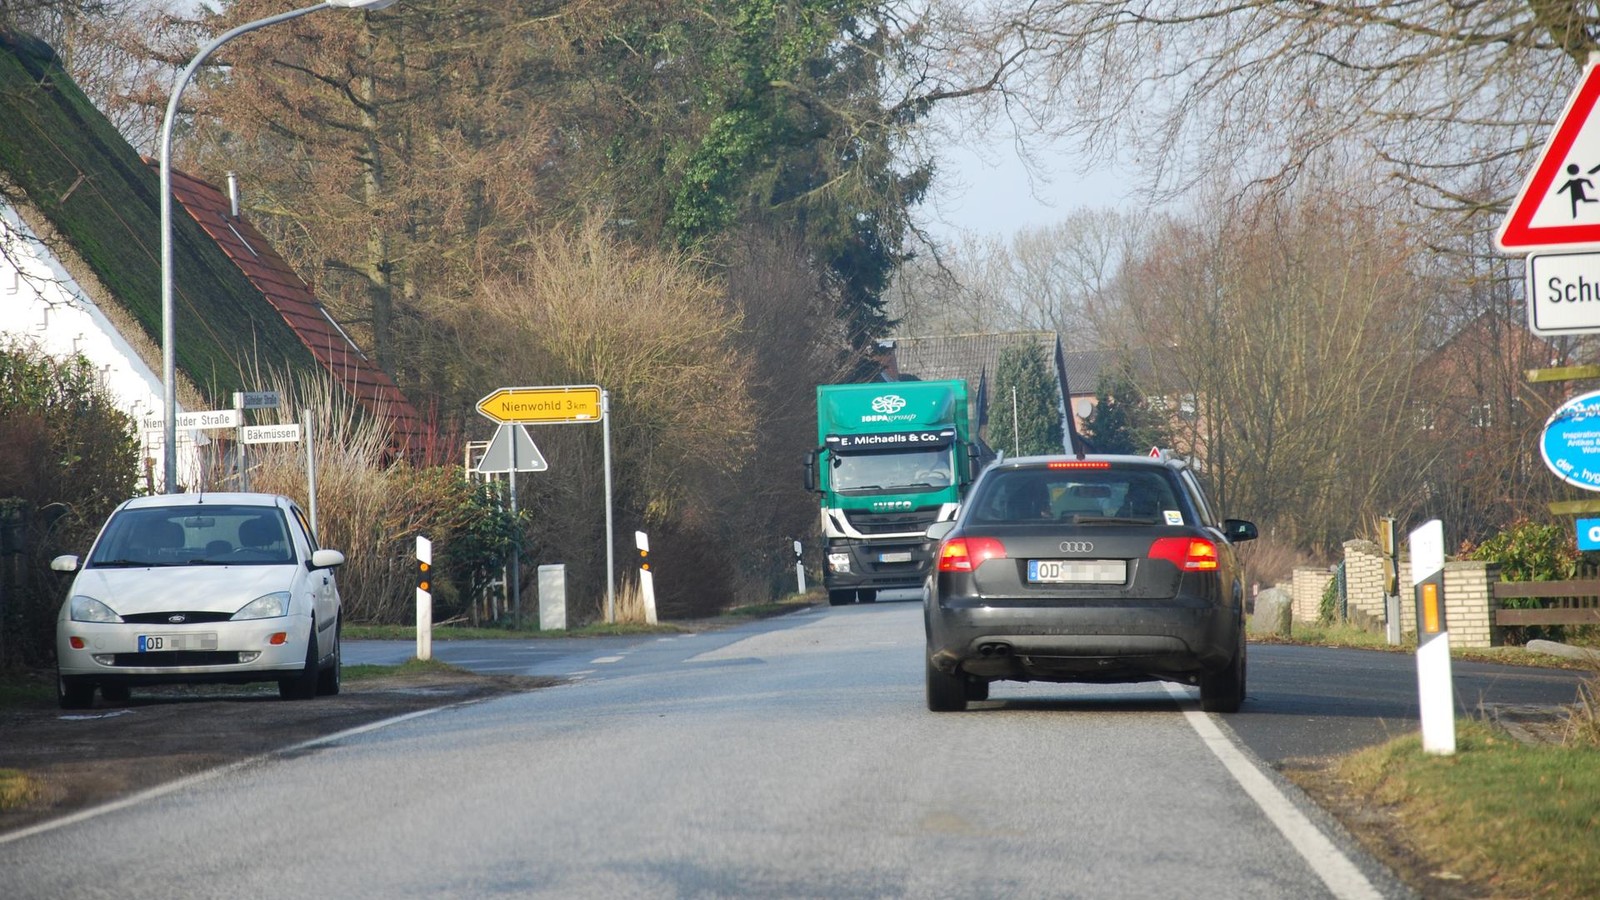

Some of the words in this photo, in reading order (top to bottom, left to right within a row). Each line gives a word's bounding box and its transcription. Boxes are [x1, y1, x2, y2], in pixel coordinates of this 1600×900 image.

[502, 401, 561, 412] Nienwohld
[143, 416, 197, 428] Nienhlder
[202, 414, 230, 426] Straße
[247, 429, 297, 440] Bäkmüssen
[841, 437, 851, 446] E.
[854, 434, 907, 445] Michaelis
[909, 434, 920, 443] &
[921, 433, 939, 442] Co.
[1556, 459, 1574, 472] der
[873, 501, 912, 512] IVECO
